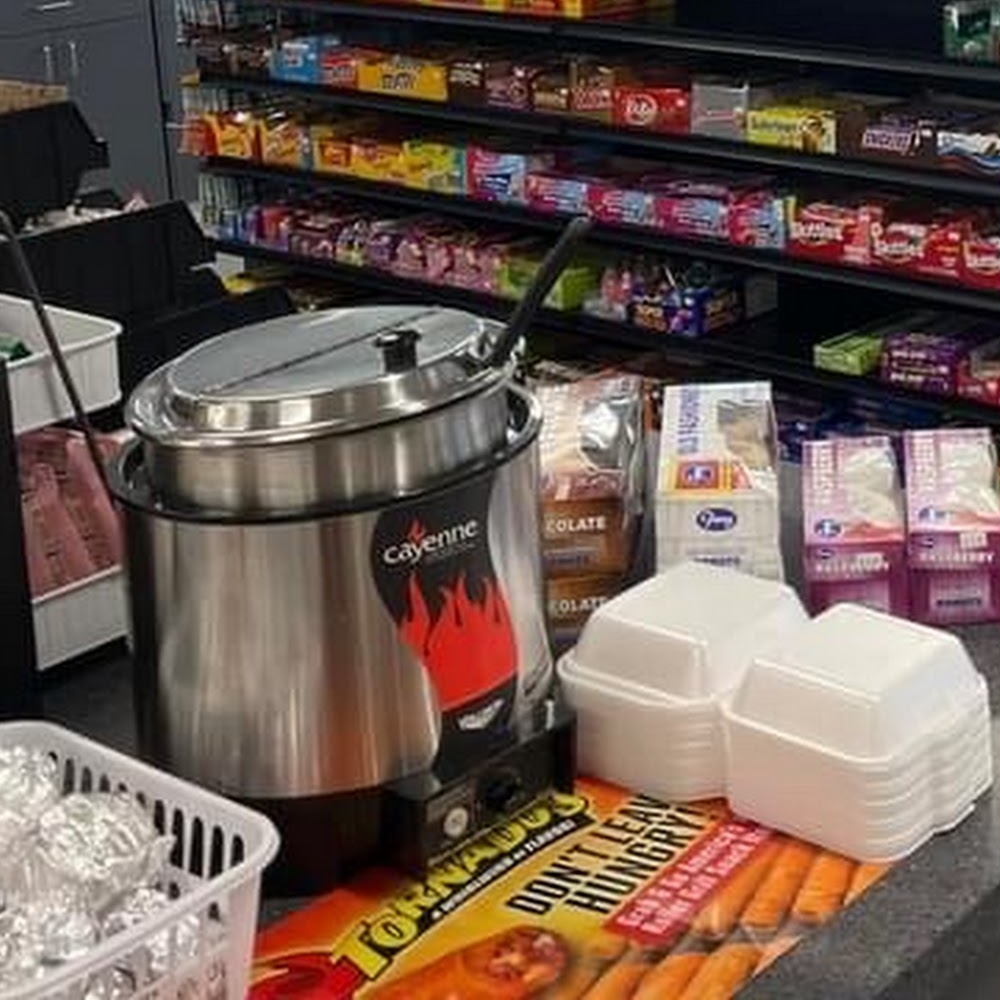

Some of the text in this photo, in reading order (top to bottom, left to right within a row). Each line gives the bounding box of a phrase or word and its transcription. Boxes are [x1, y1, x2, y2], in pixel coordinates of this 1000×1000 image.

[384, 520, 479, 564] cayenne
[506, 794, 670, 915] DON'T LEAV
